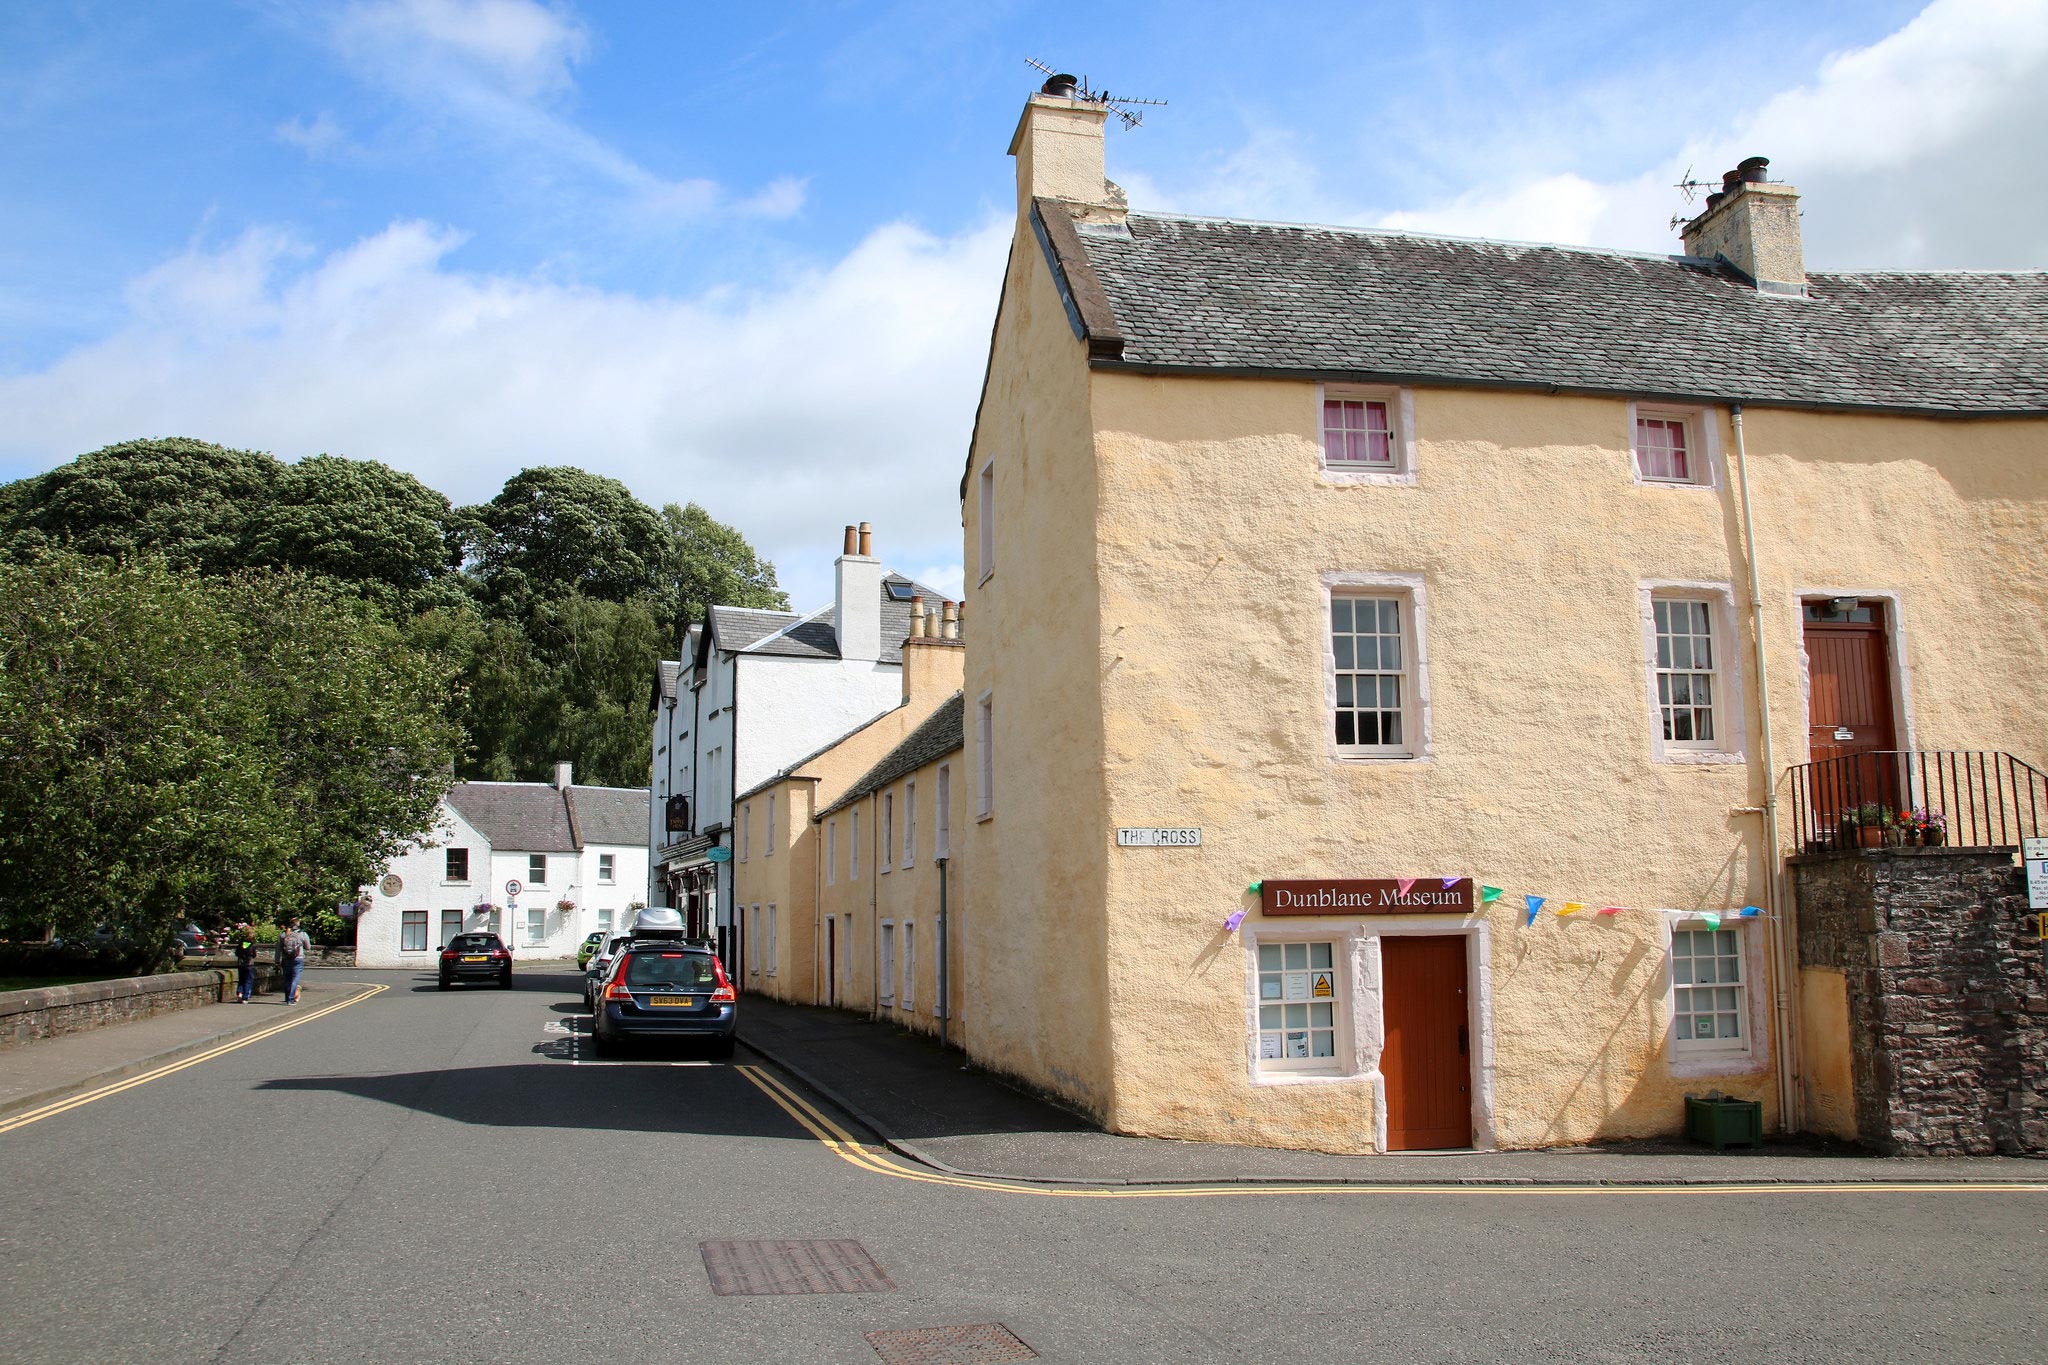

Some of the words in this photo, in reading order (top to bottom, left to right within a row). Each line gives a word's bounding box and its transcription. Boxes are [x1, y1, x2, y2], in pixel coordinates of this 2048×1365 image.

[1152, 830, 1196, 844] CROSS
[1275, 887, 1372, 908] Dunblane
[1378, 888, 1462, 907] Museum
